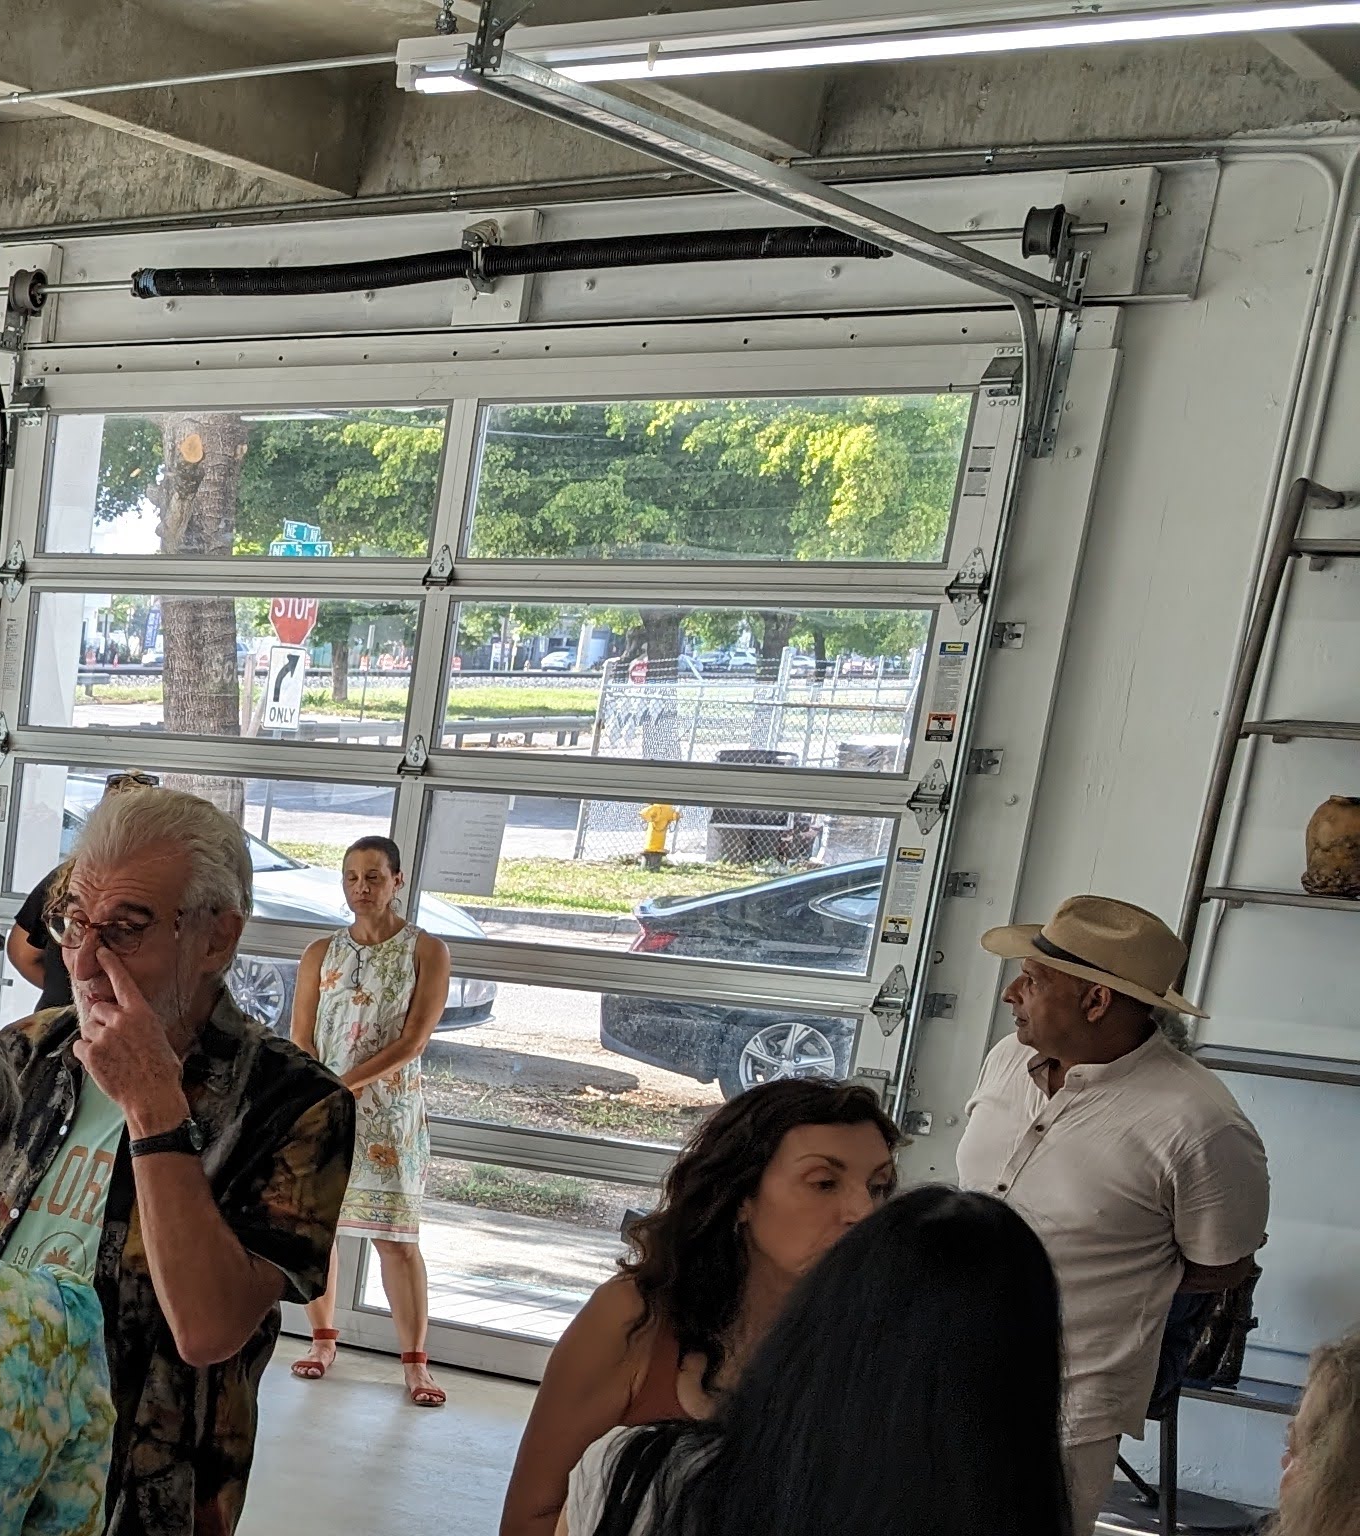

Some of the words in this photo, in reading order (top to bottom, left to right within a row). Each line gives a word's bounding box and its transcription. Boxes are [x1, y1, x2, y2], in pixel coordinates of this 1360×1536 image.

[286, 523, 298, 539] NE
[314, 544, 328, 556] ST
[274, 598, 315, 619] STOP
[269, 707, 295, 724] ONLY
